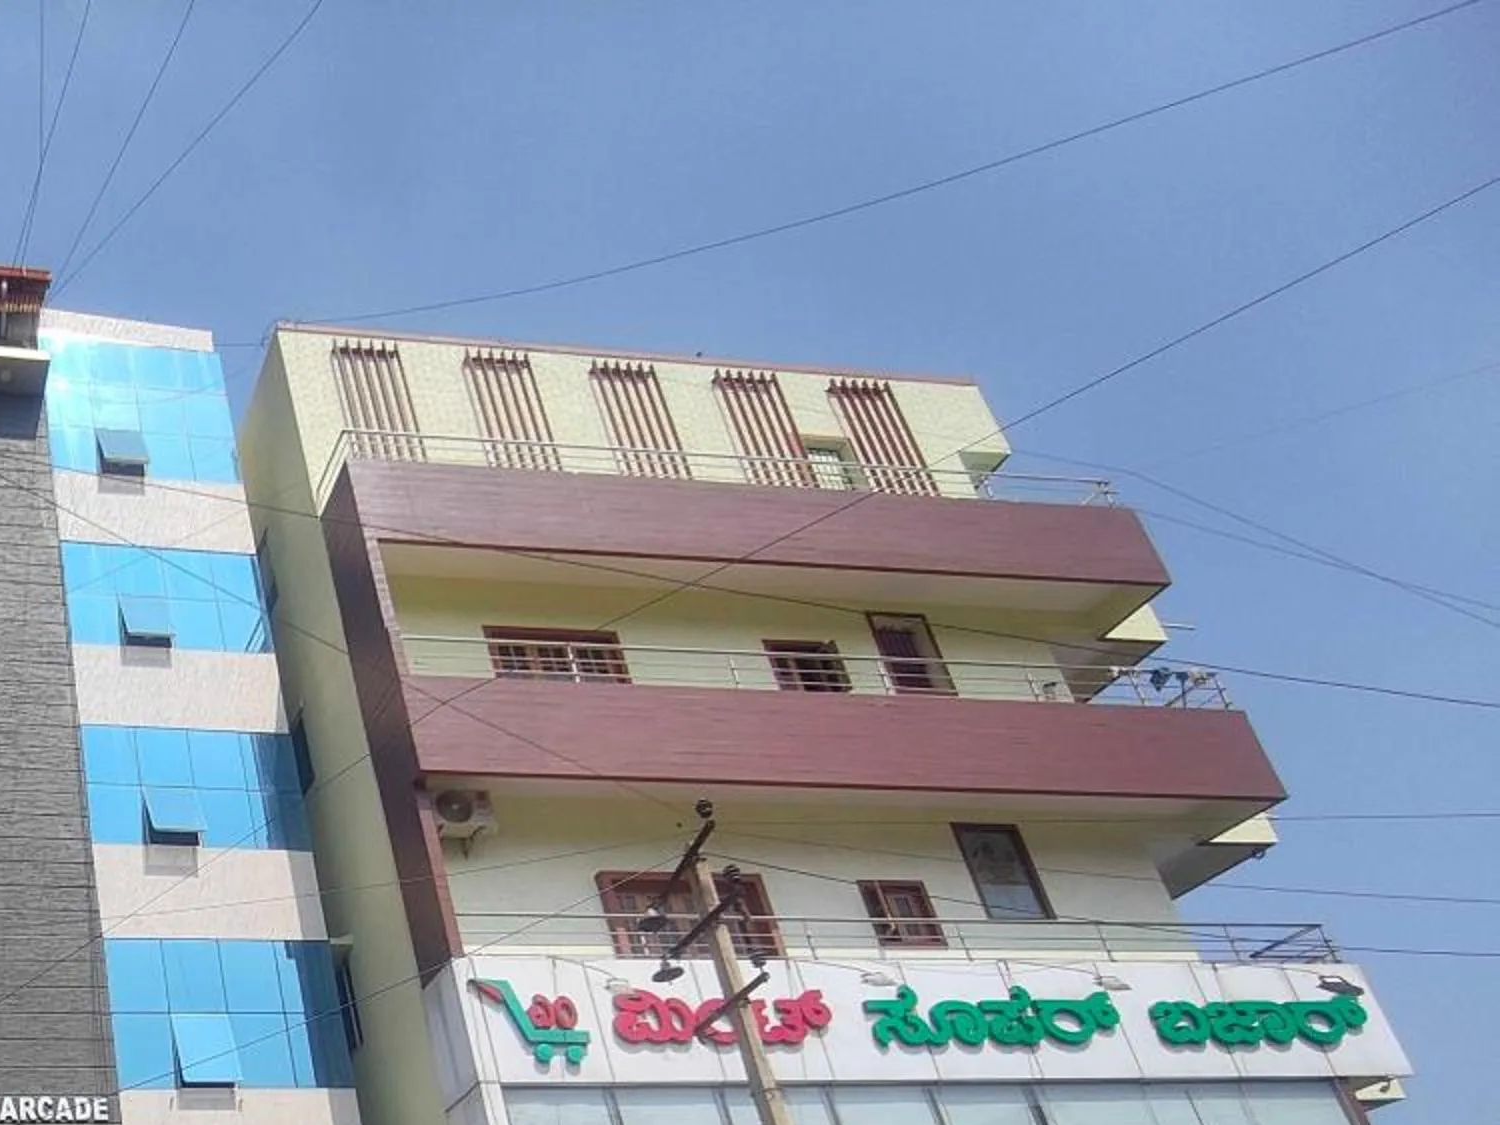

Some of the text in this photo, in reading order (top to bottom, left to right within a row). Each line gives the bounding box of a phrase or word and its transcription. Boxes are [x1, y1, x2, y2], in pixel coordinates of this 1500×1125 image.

[864, 984, 1121, 1048] ಸೂಪರ್
[1152, 993, 1368, 1046] ಬಜಾರ್
[0, 1095, 110, 1122] ARCADE
